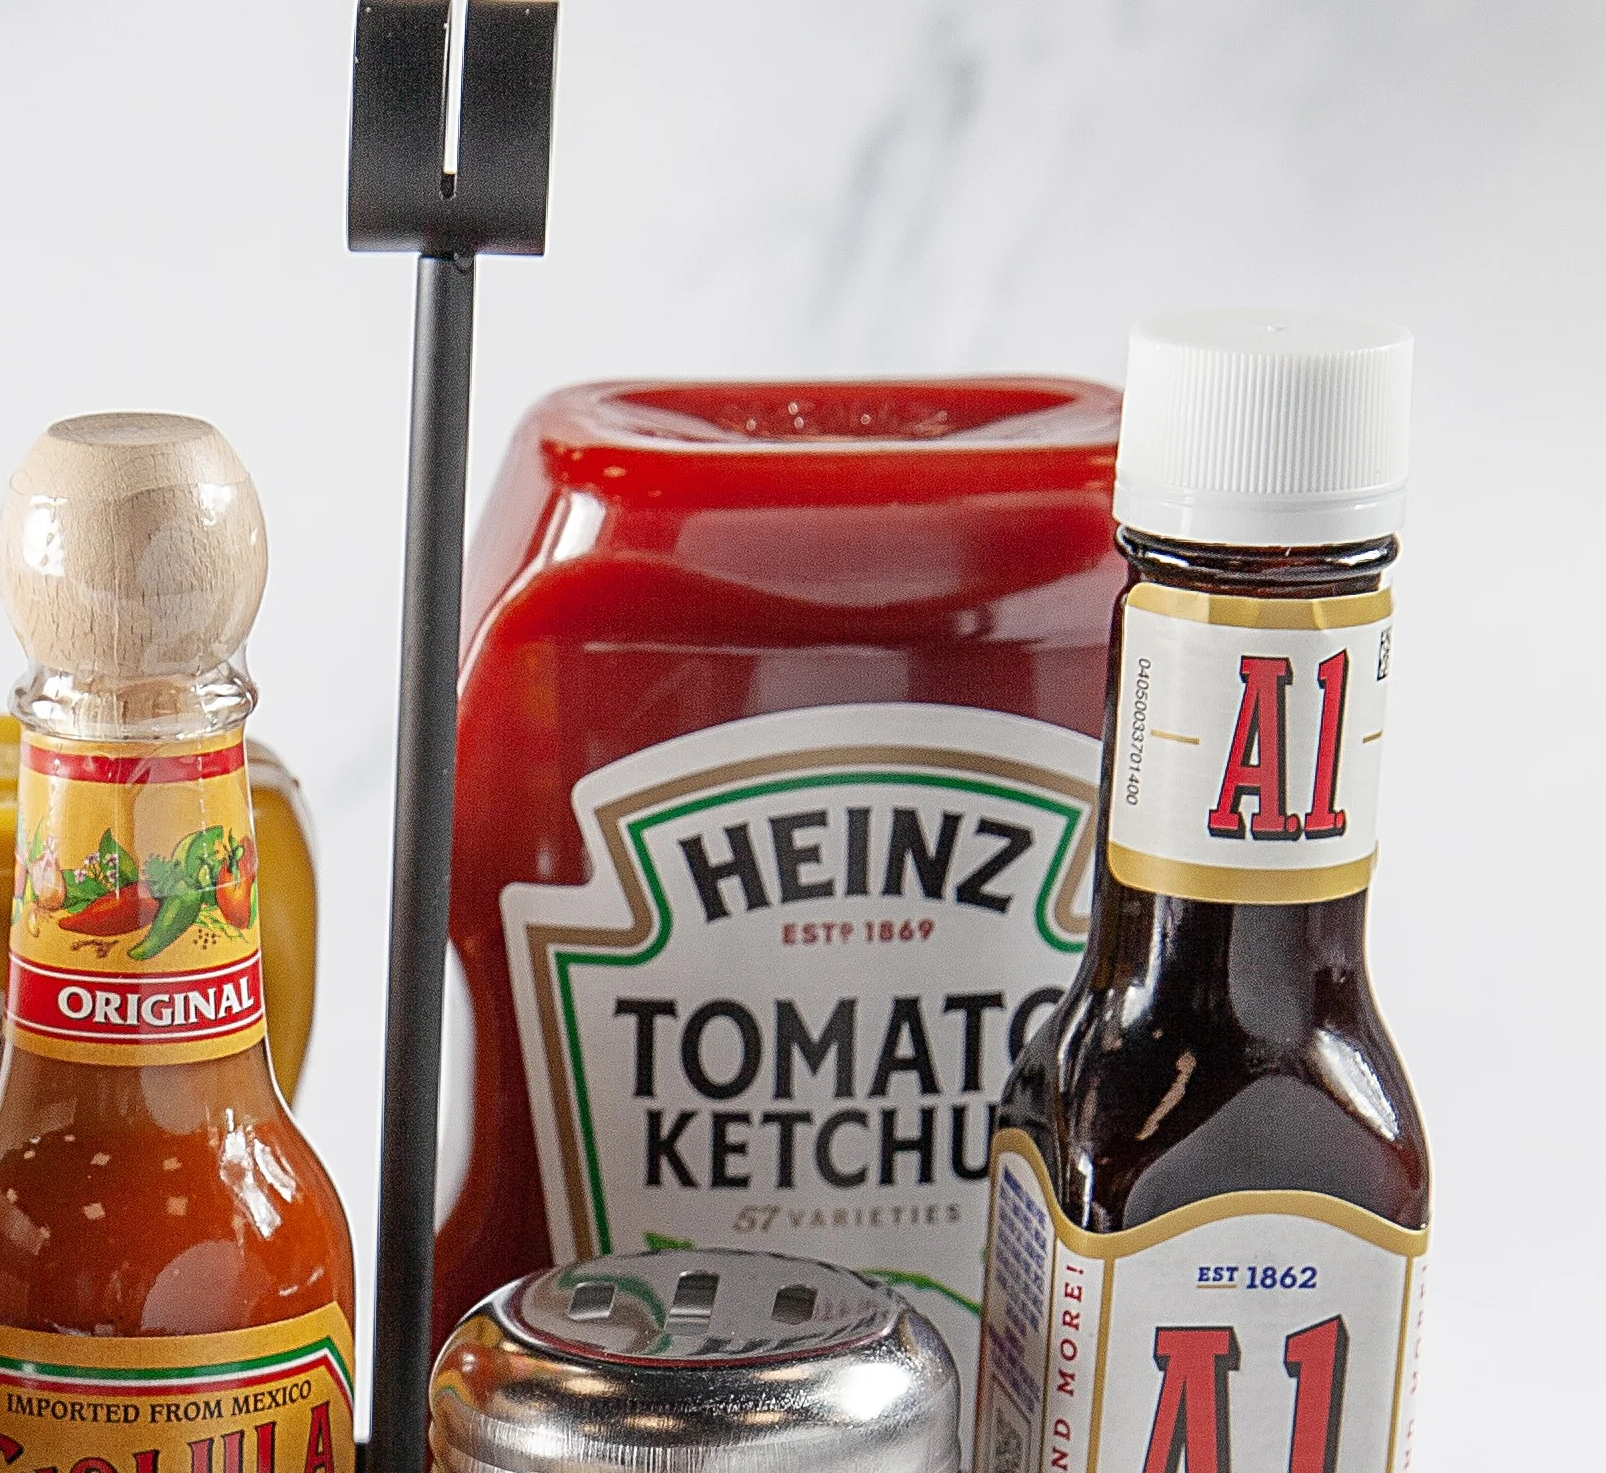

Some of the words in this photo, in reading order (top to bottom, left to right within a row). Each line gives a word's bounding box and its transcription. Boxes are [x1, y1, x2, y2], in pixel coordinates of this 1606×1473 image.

[678, 807, 1034, 922] HEINZ
[864, 919, 935, 943] 1869
[57, 976, 255, 1027] ORIGINAL
[644, 1103, 993, 1190] KETCHU
[1197, 1266, 1238, 1284] EST
[1247, 1266, 1318, 1290] 1862
[1056, 1263, 1085, 1398] MORE!
[6, 1392, 140, 1425] IMPORTED
[149, 1398, 224, 1424] FROM
[231, 1379, 312, 1417] MEXICO
